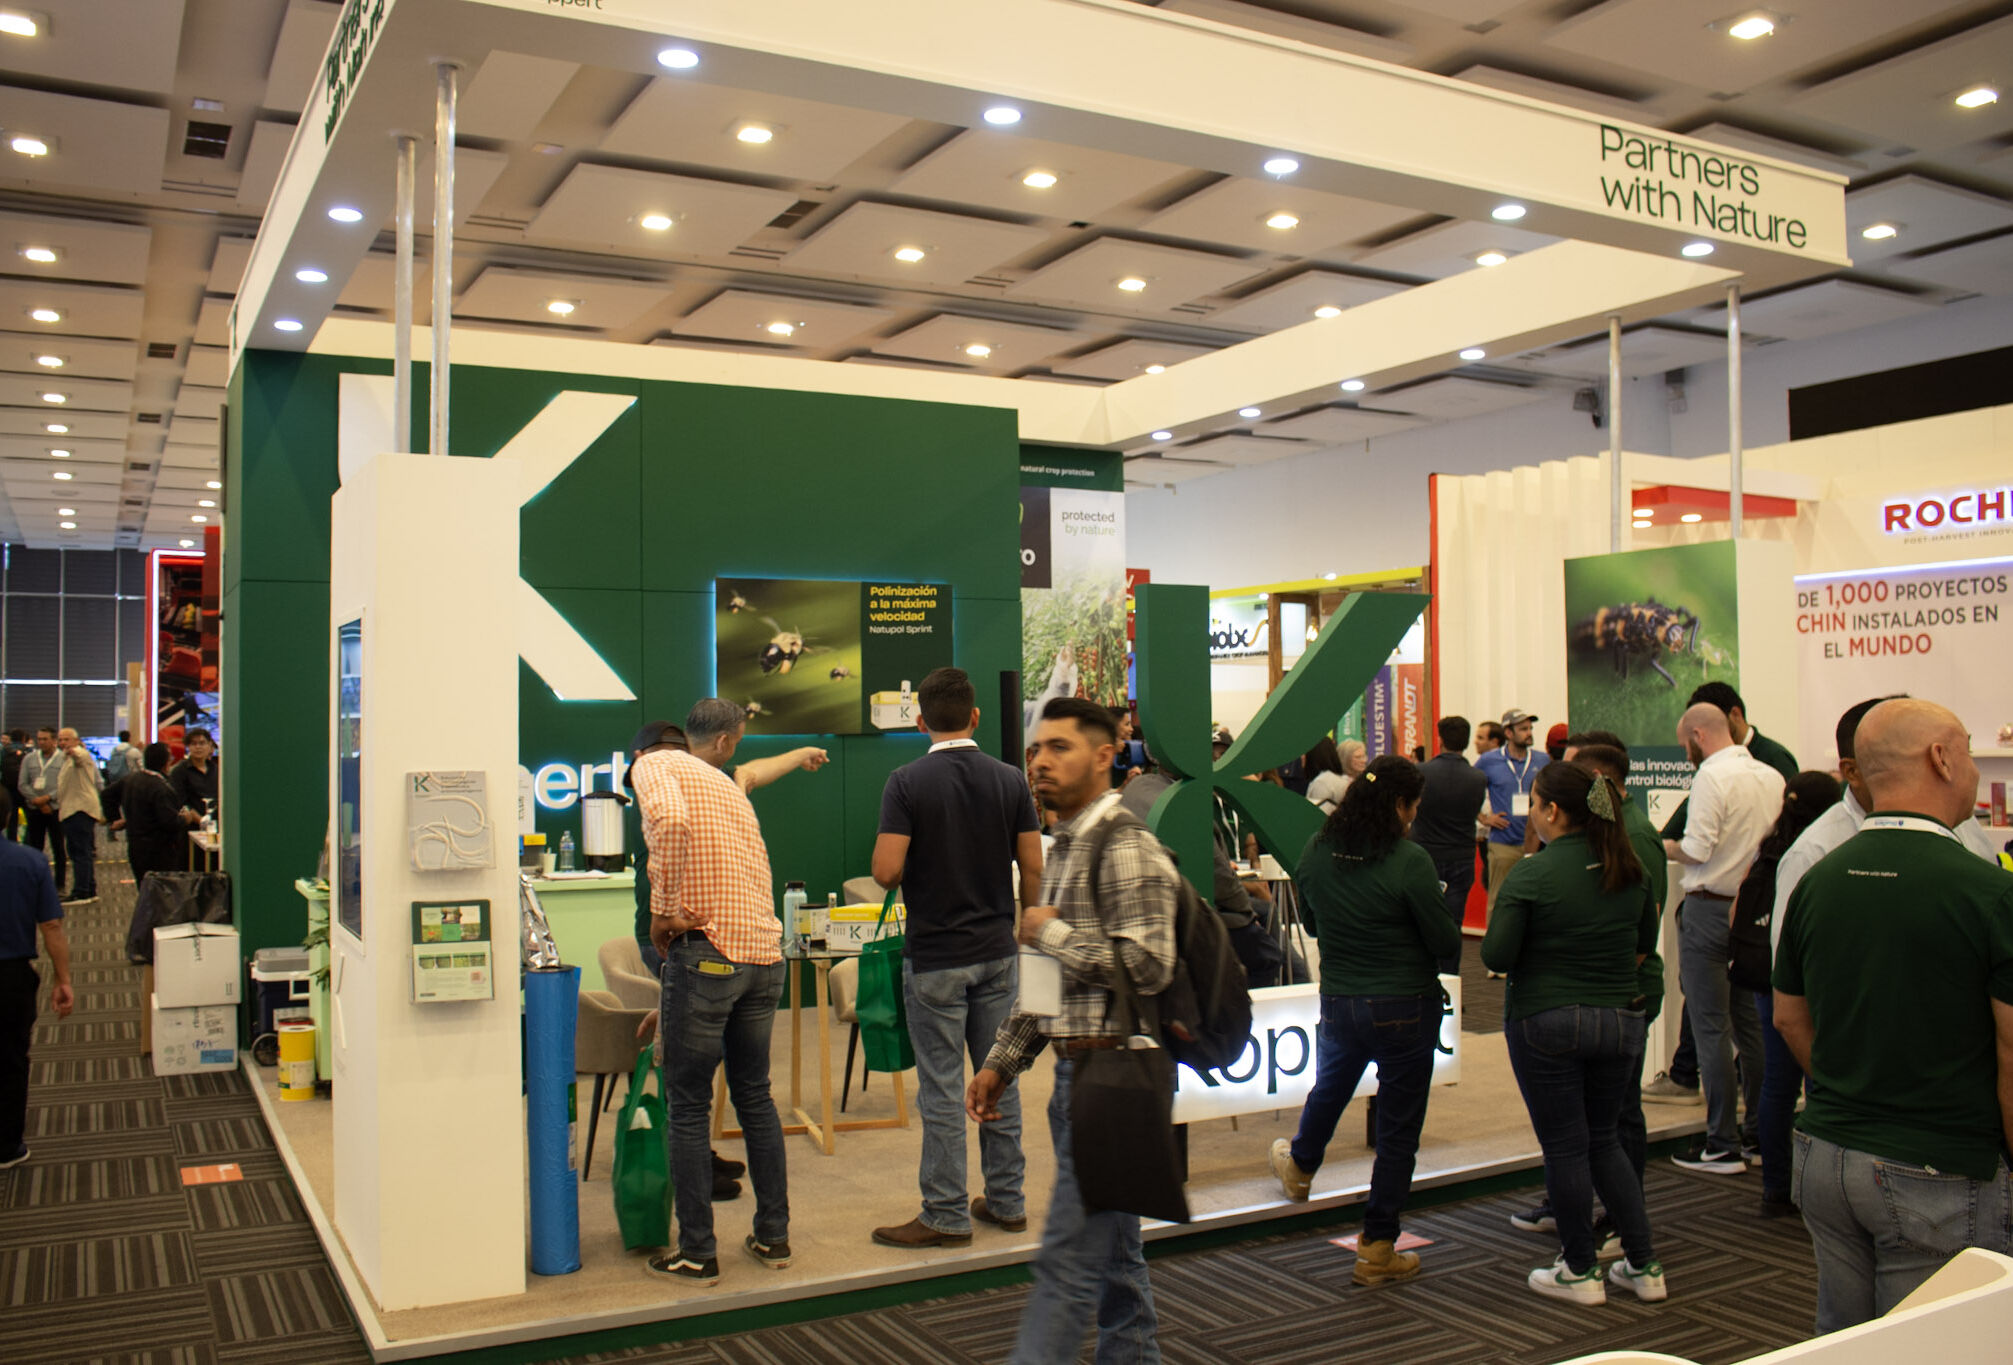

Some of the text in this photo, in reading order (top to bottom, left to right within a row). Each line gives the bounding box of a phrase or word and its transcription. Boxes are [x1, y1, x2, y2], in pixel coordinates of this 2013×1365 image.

[1600, 123, 1760, 196] Partners
[1600, 176, 1807, 249] with Nature
[1046, 467, 1060, 476] crop
[1061, 468, 1095, 477] protection
[1062, 510, 1115, 524] protected
[1065, 524, 1115, 537] by nature
[1979, 528, 2013, 537] INNOV
[869, 585, 937, 596] Polinización
[1798, 575, 2008, 610] DE 1,000 PROYECTOS
[869, 598, 937, 609] a la máxima
[869, 611, 926, 622] velocidad
[1796, 605, 1998, 634] CHIN INSTALADOS EN
[869, 625, 933, 635] Natupol Sprint
[1824, 633, 1932, 659] EL MUNDO
[1404, 676, 1417, 756] BRANDT
